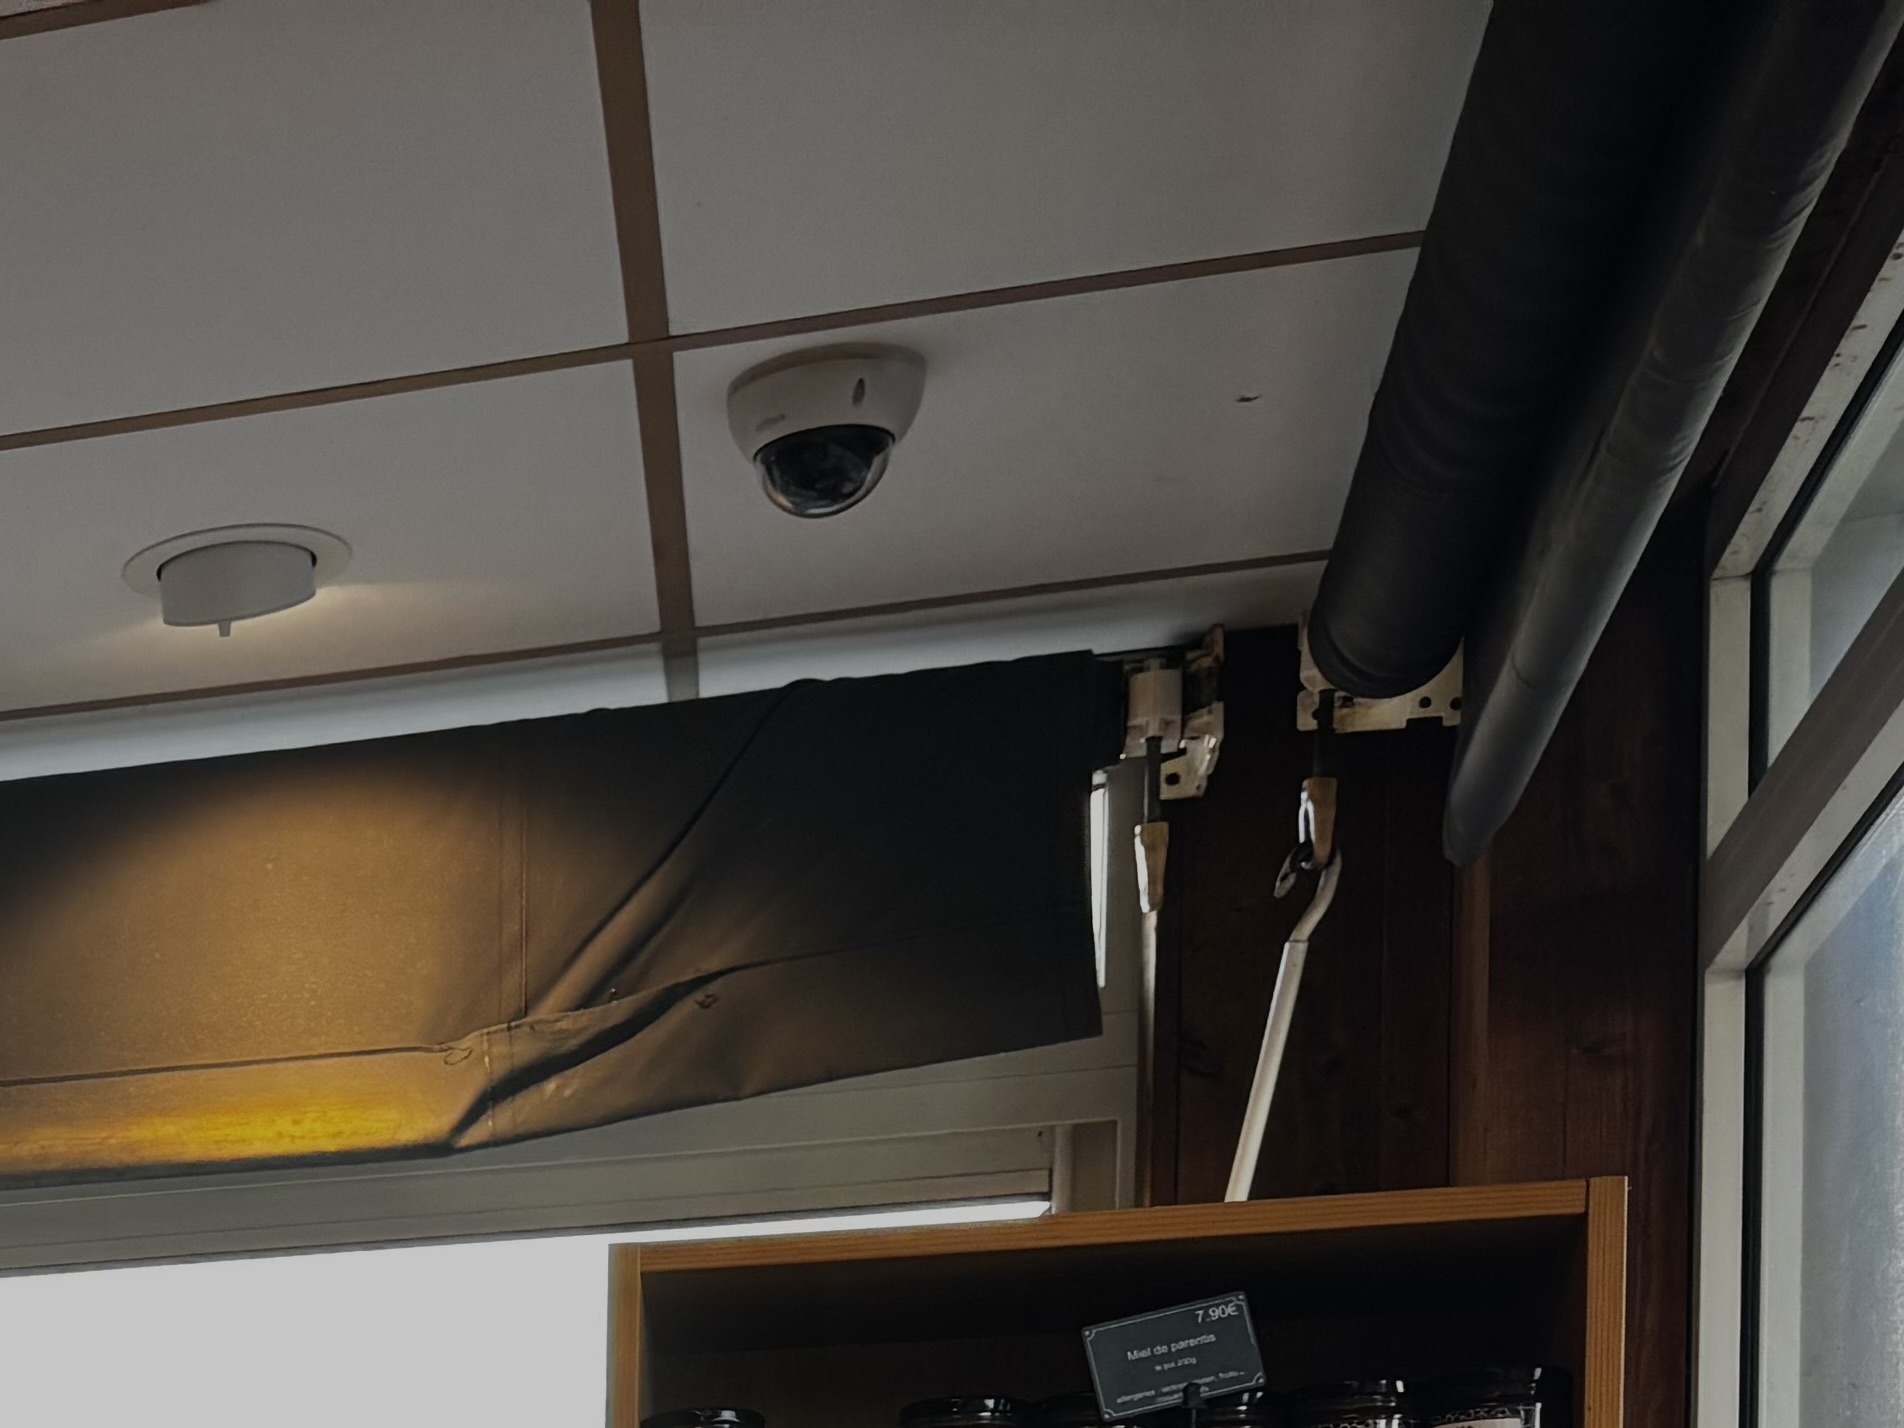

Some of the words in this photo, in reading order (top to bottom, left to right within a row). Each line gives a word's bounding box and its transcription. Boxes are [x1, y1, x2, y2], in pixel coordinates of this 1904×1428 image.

[1194, 1303, 1239, 1324] 7.90€
[1126, 1347, 1151, 1361] Miel
[1153, 1343, 1168, 1356] de
